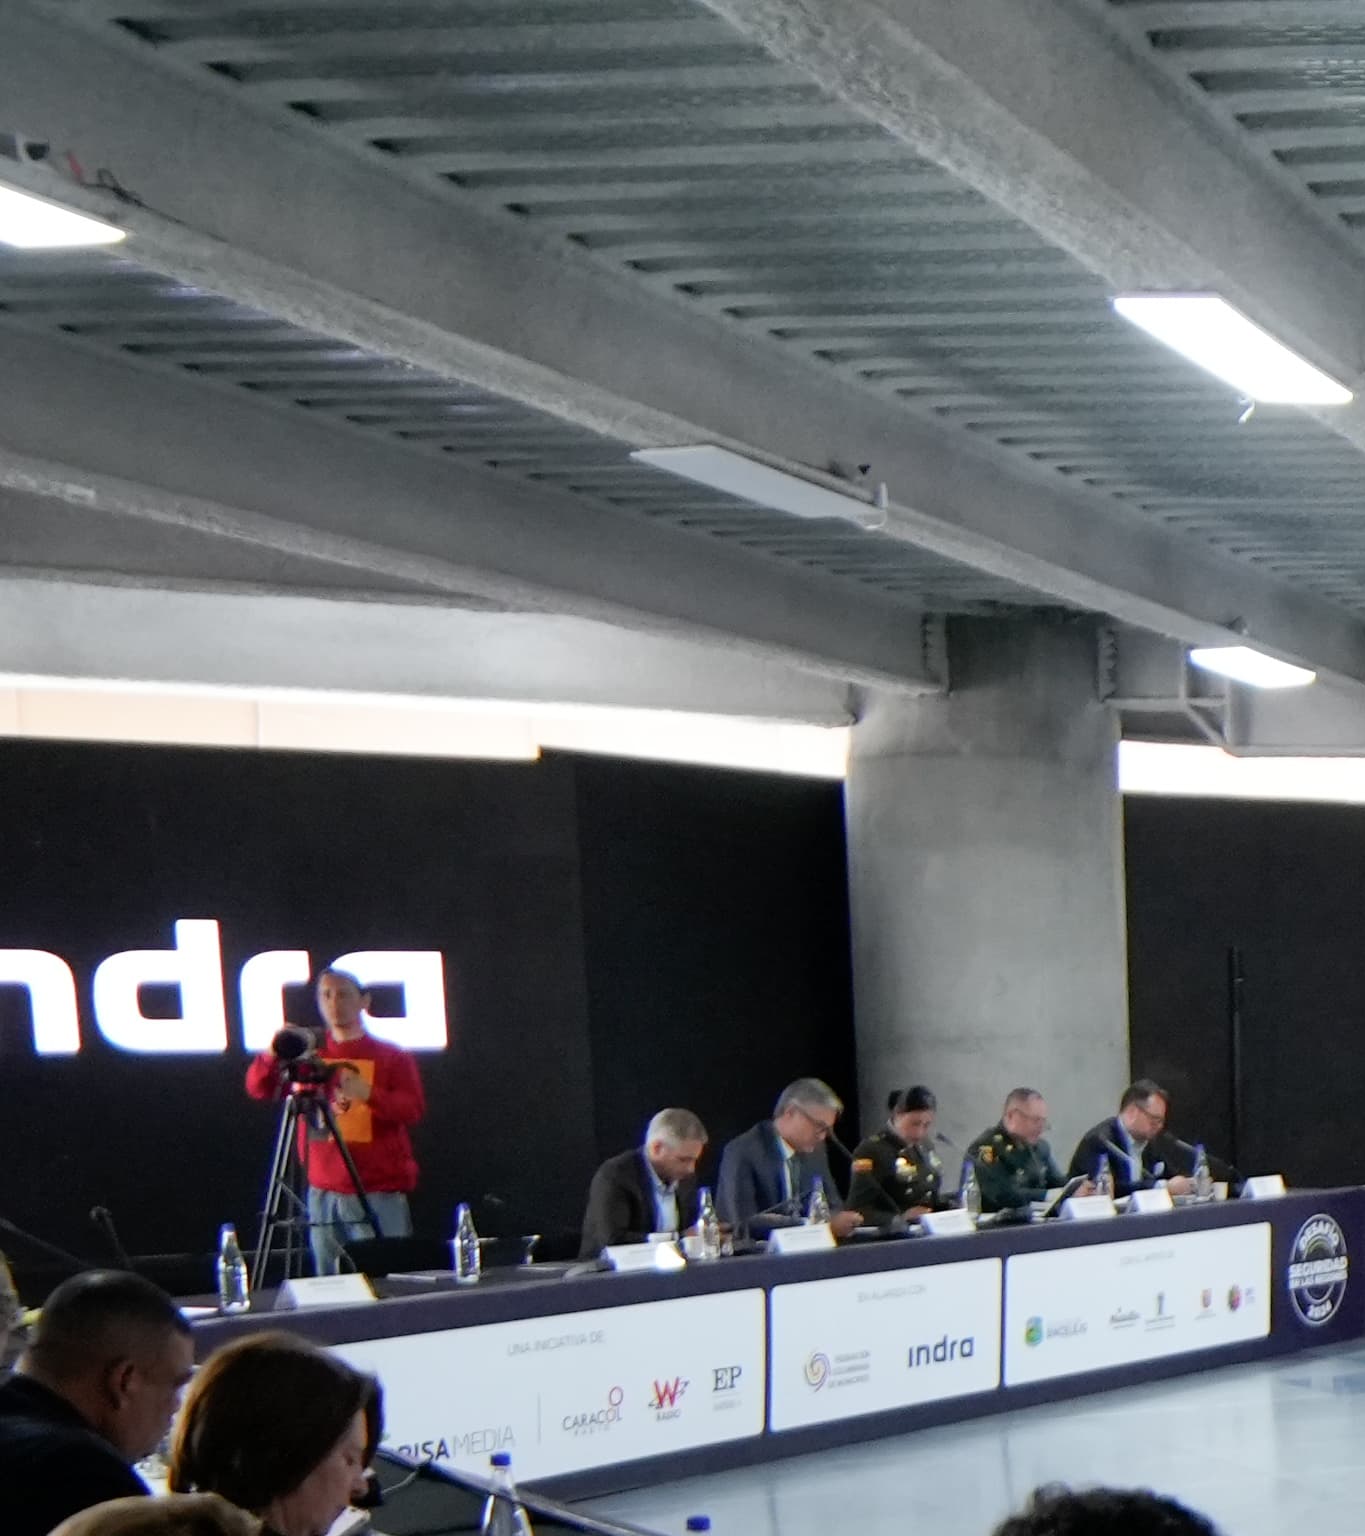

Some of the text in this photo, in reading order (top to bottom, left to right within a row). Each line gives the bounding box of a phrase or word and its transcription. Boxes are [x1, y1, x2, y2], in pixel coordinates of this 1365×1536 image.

[0, 918, 448, 1057] ndra
[1289, 1256, 1348, 1278] SEGURIDAD
[907, 1333, 974, 1369] indra
[712, 1366, 743, 1393] EP
[562, 1405, 624, 1431] CARACOL
[452, 1424, 516, 1458] MEDIA
